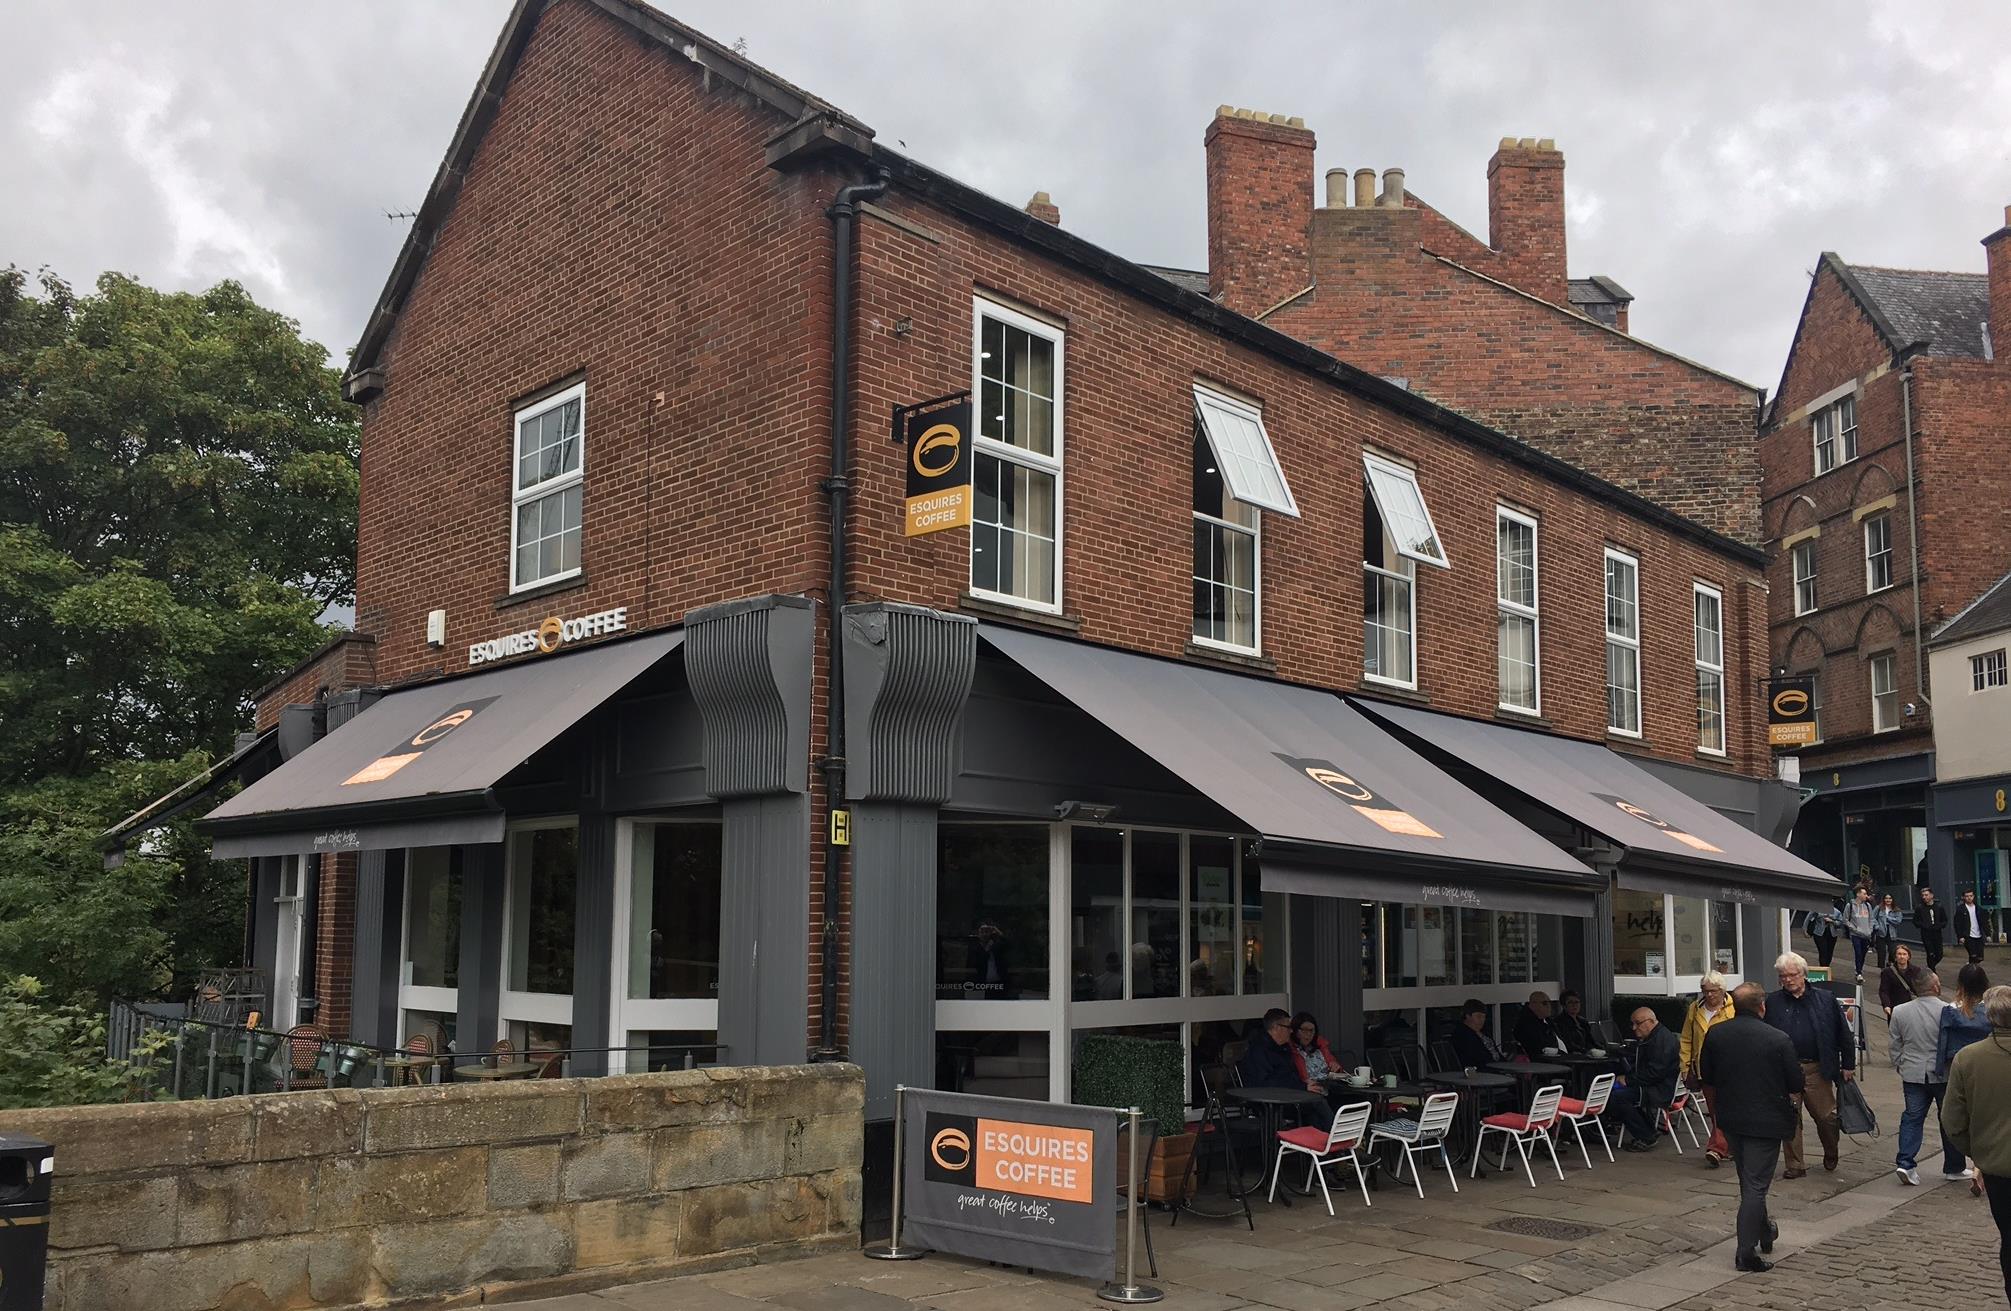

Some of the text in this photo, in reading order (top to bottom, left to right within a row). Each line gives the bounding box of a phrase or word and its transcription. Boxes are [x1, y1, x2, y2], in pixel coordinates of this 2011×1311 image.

[910, 493, 962, 515] ESQUIRES
[915, 509, 957, 527] COFFEE
[469, 607, 628, 665] ESQUIRES COFFEE
[1772, 725, 1811, 733] ESQUIRES
[1776, 732, 1808, 741] COFFEE
[1833, 772, 1840, 786] 8
[1995, 788, 2006, 812] 8
[1805, 974, 1825, 983] rand
[984, 1131, 1089, 1162] ESQUIRES
[995, 1160, 1077, 1189] COFFEE
[957, 1194, 986, 1210] great
[988, 1195, 1017, 1217] coffee
